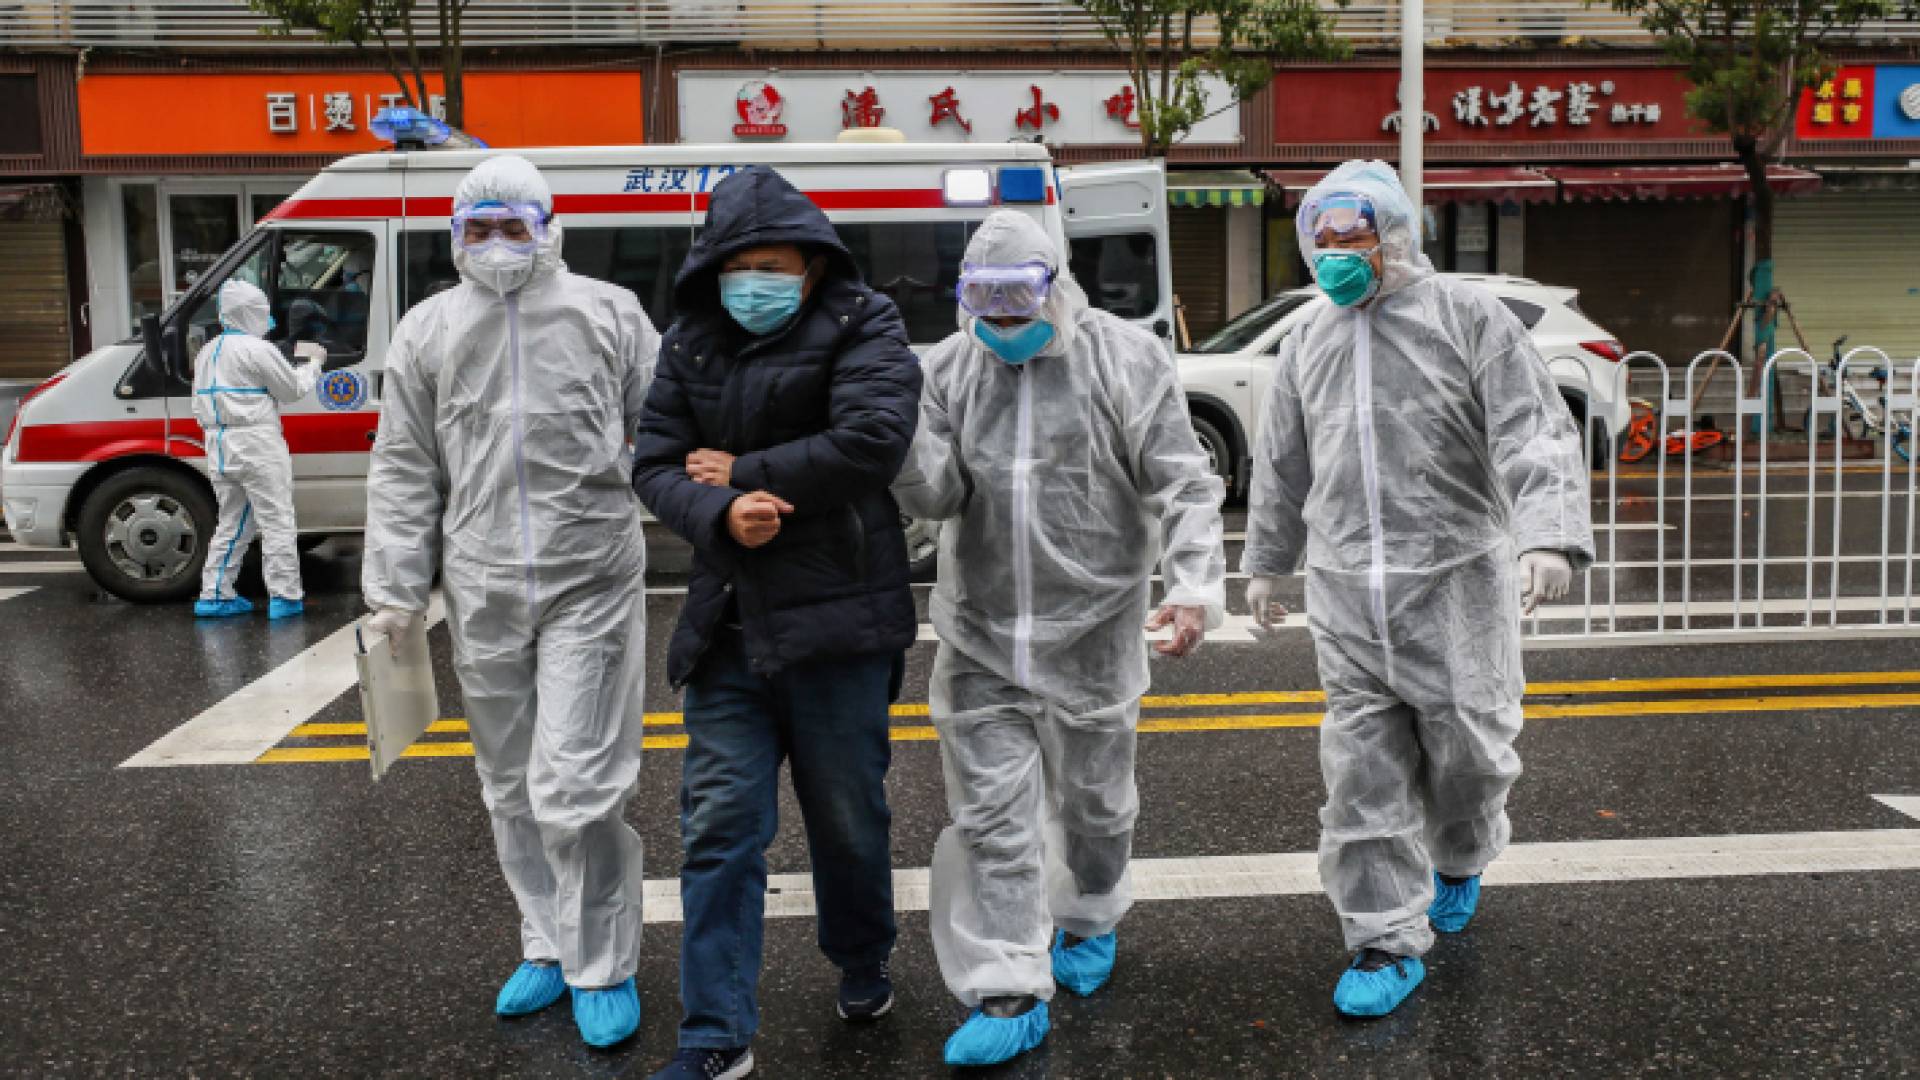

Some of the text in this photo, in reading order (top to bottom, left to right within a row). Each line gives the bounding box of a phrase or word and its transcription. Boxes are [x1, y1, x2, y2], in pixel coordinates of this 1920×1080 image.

[841, 84, 1142, 133] 潘氏小吃
[624, 165, 754, 192] 武汉1
